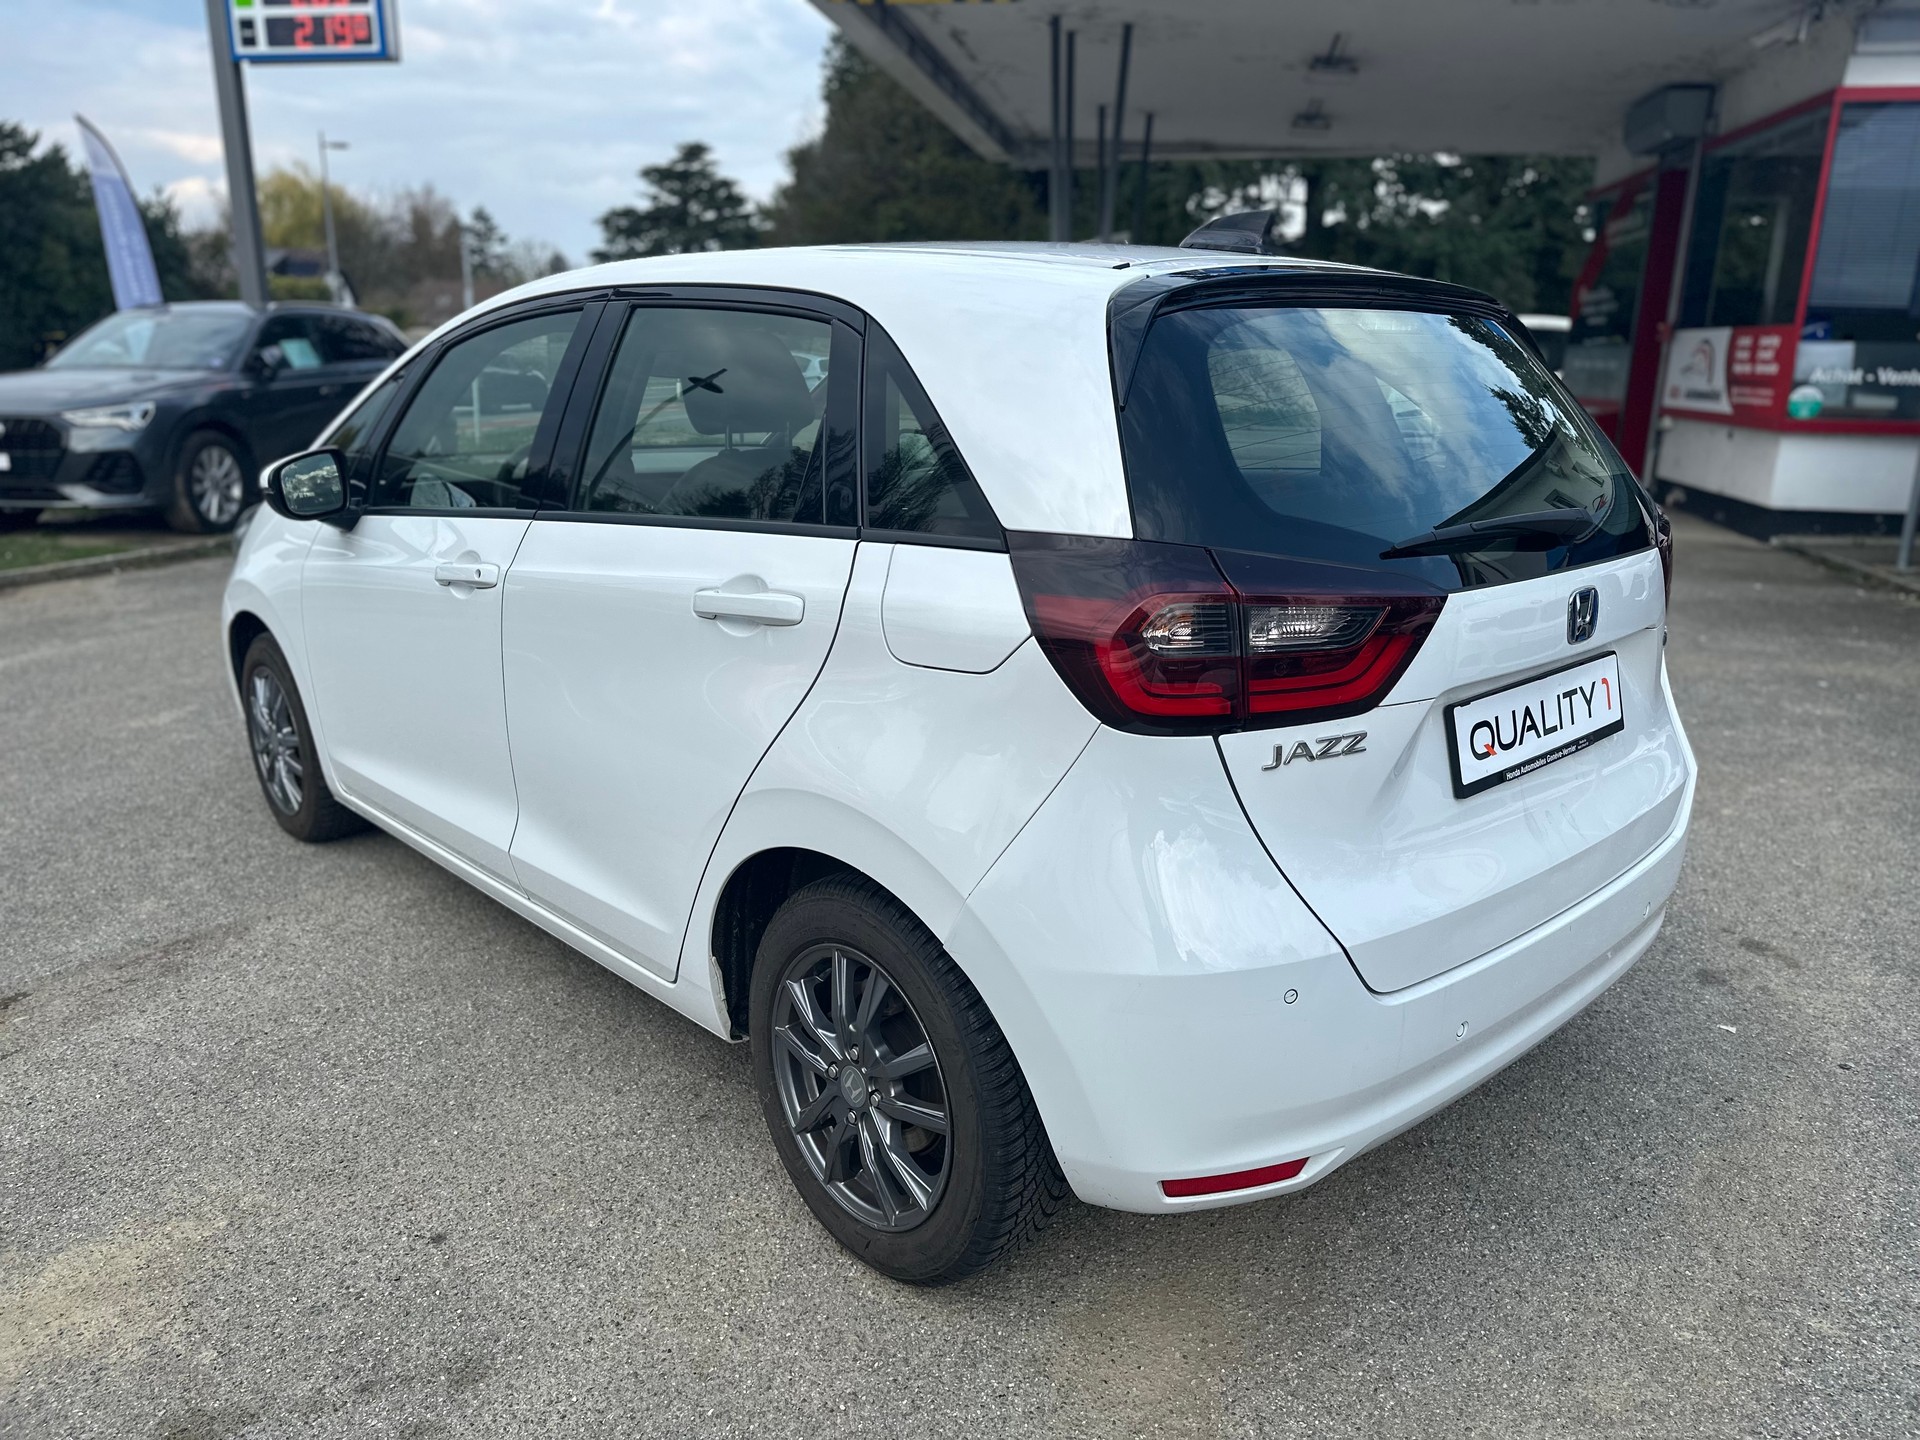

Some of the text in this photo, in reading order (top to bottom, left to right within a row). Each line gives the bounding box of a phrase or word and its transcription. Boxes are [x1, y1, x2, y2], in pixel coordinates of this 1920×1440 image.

[1808, 366, 1864, 385] Achat
[1470, 681, 1596, 760] QUALITY
[1261, 730, 1368, 771] JAZZ
[1506, 768, 1521, 780] Honda
[1521, 757, 1546, 774] Automobiles
